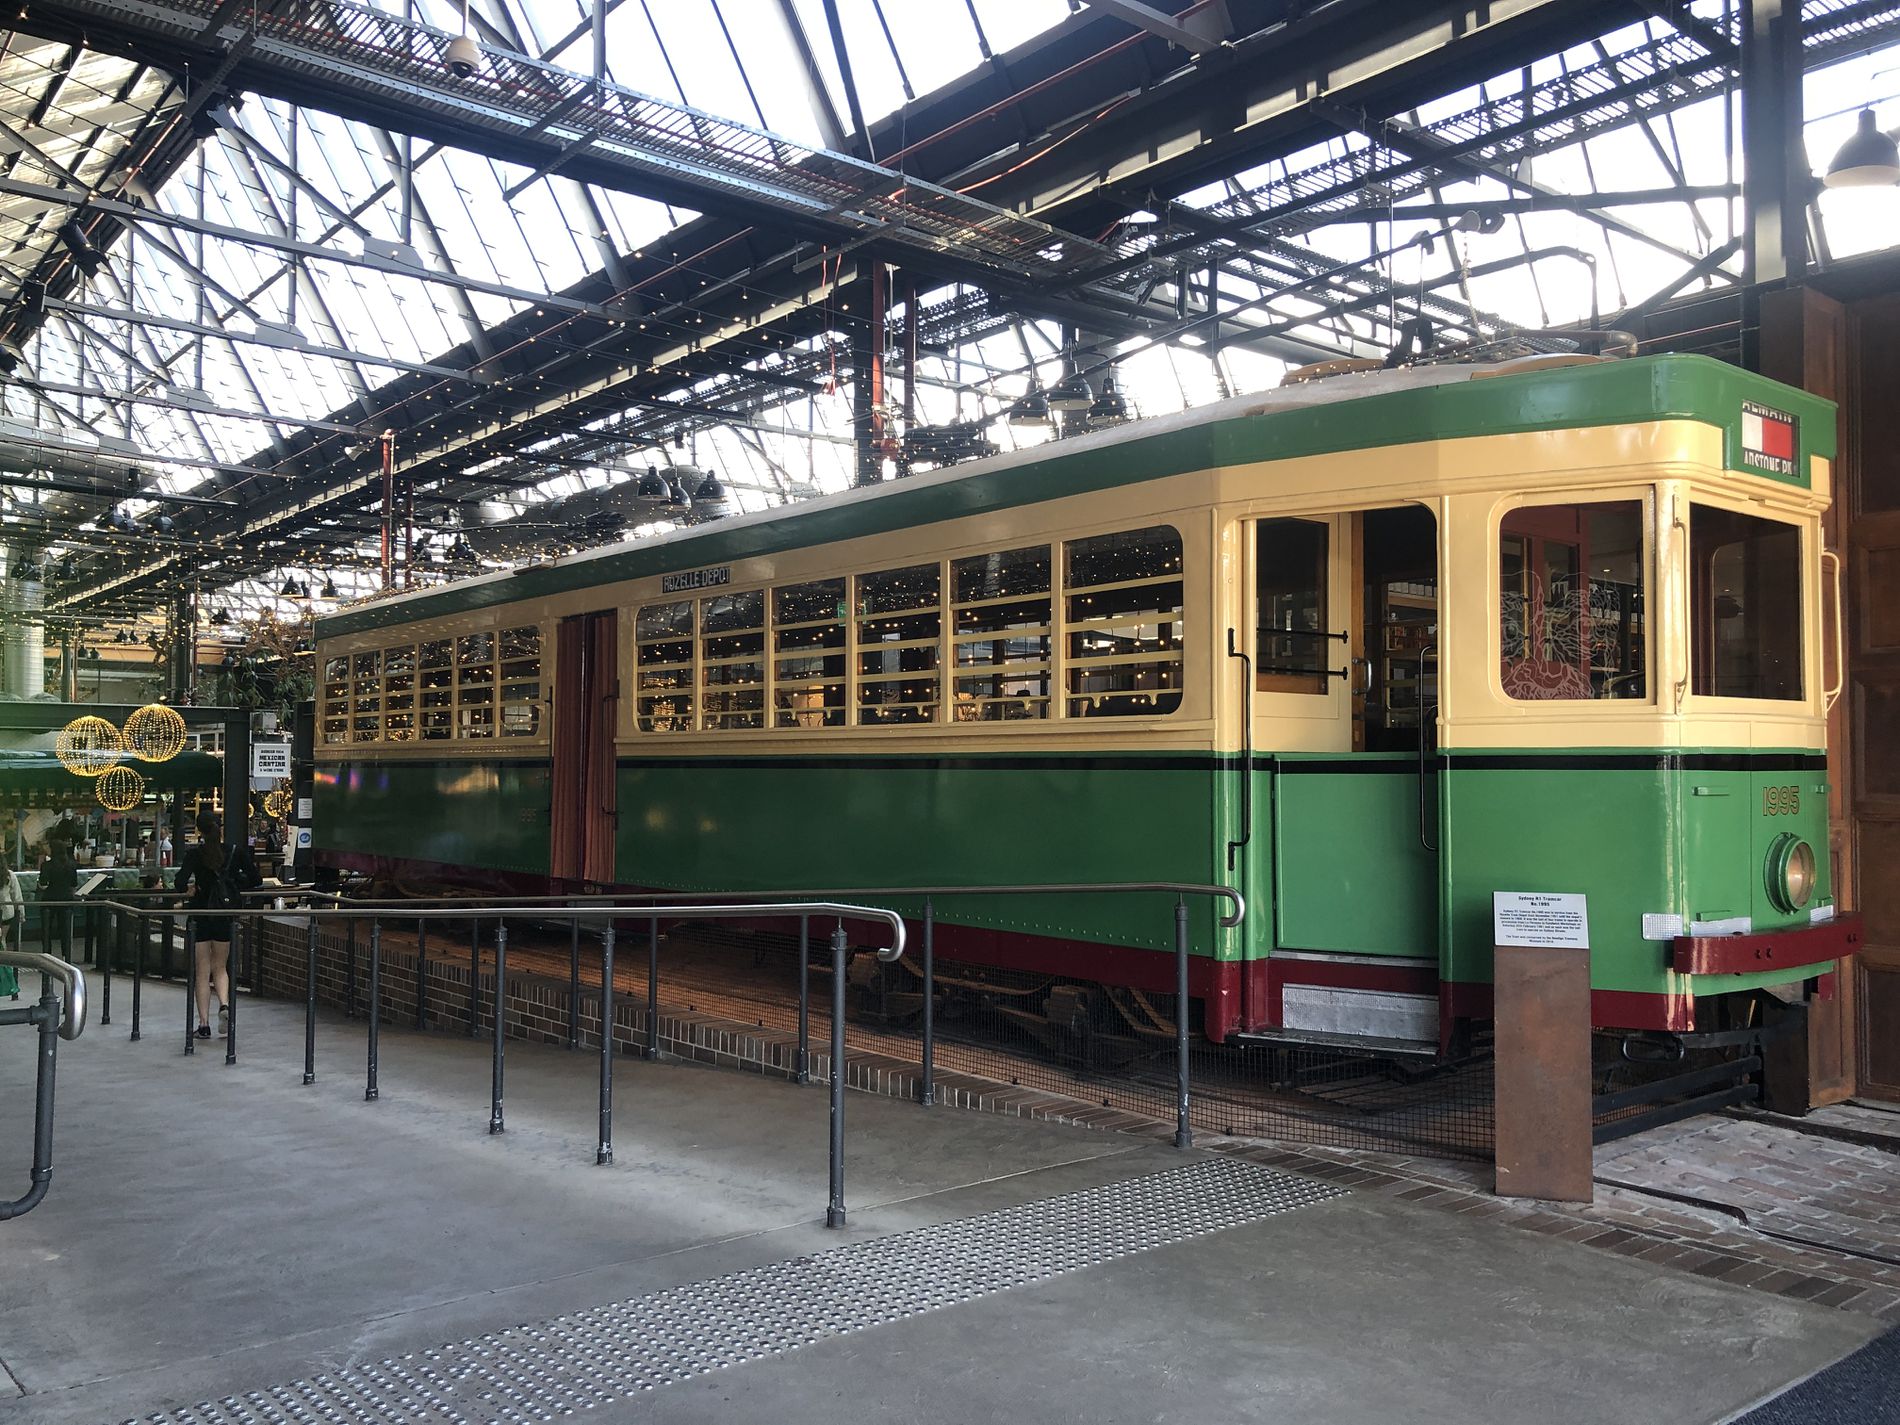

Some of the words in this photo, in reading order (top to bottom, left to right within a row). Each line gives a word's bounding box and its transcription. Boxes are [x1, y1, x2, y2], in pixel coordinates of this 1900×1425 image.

[663, 571, 700, 593] ROZELLE
[702, 567, 730, 587] DEPOT
[1762, 785, 1800, 817] 1995
